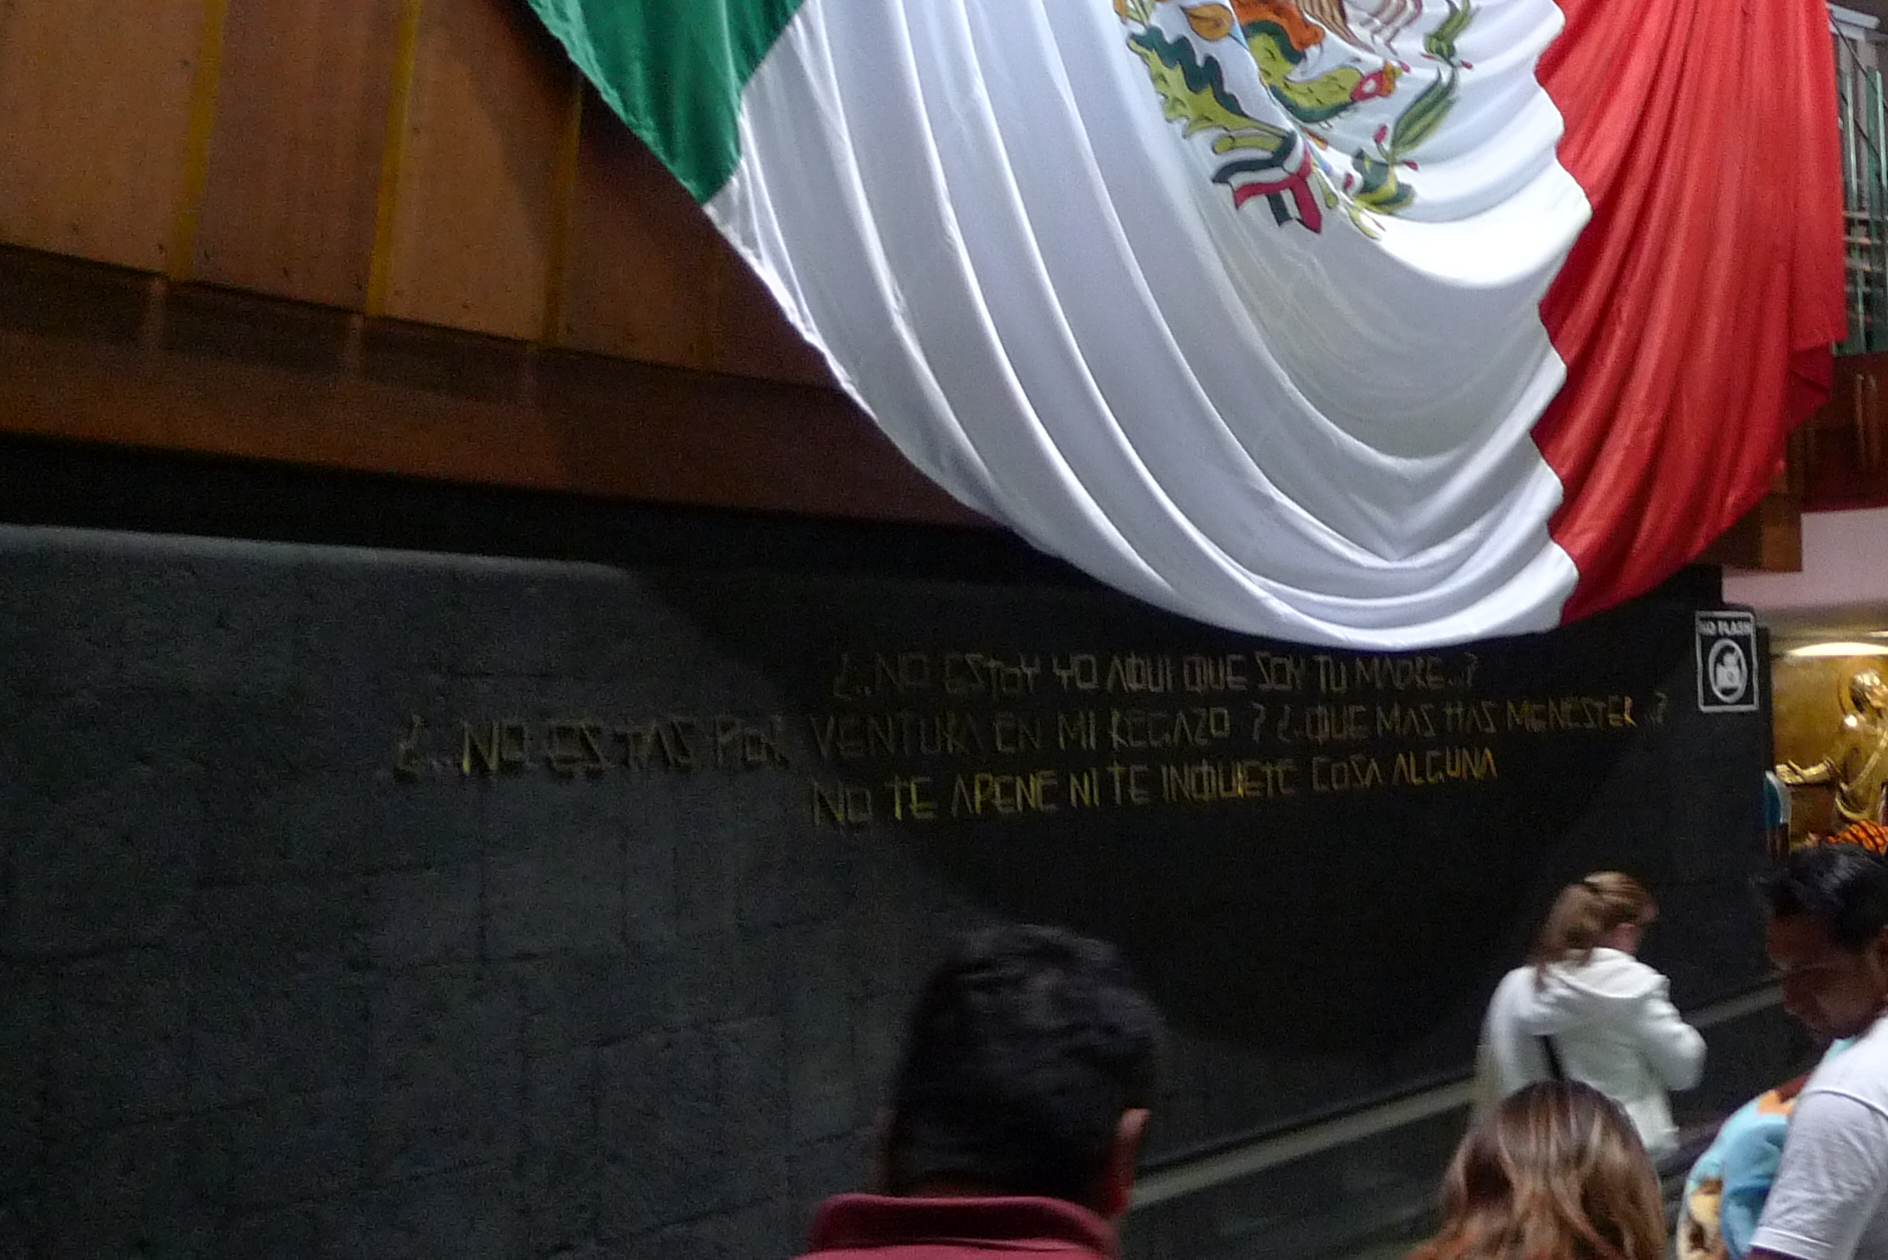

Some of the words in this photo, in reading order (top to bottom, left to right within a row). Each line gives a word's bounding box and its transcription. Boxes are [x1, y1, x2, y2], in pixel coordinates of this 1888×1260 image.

[1698, 621, 1716, 635] NO
[1718, 620, 1751, 636] FLASH
[1052, 652, 1098, 691] YO
[1183, 652, 1248, 694] QUE
[1312, 653, 1347, 694] TU
[461, 718, 529, 775] NO
[993, 710, 1042, 754] EN
[1057, 710, 1097, 751] MI
[1304, 702, 1367, 745] QUE
[1376, 701, 1436, 739] MAS
[811, 777, 873, 831] NO
[885, 774, 939, 821] TE
[1068, 767, 1101, 809] NI
[1106, 760, 1151, 807] TE
[1391, 746, 1498, 786] ALGUNA
